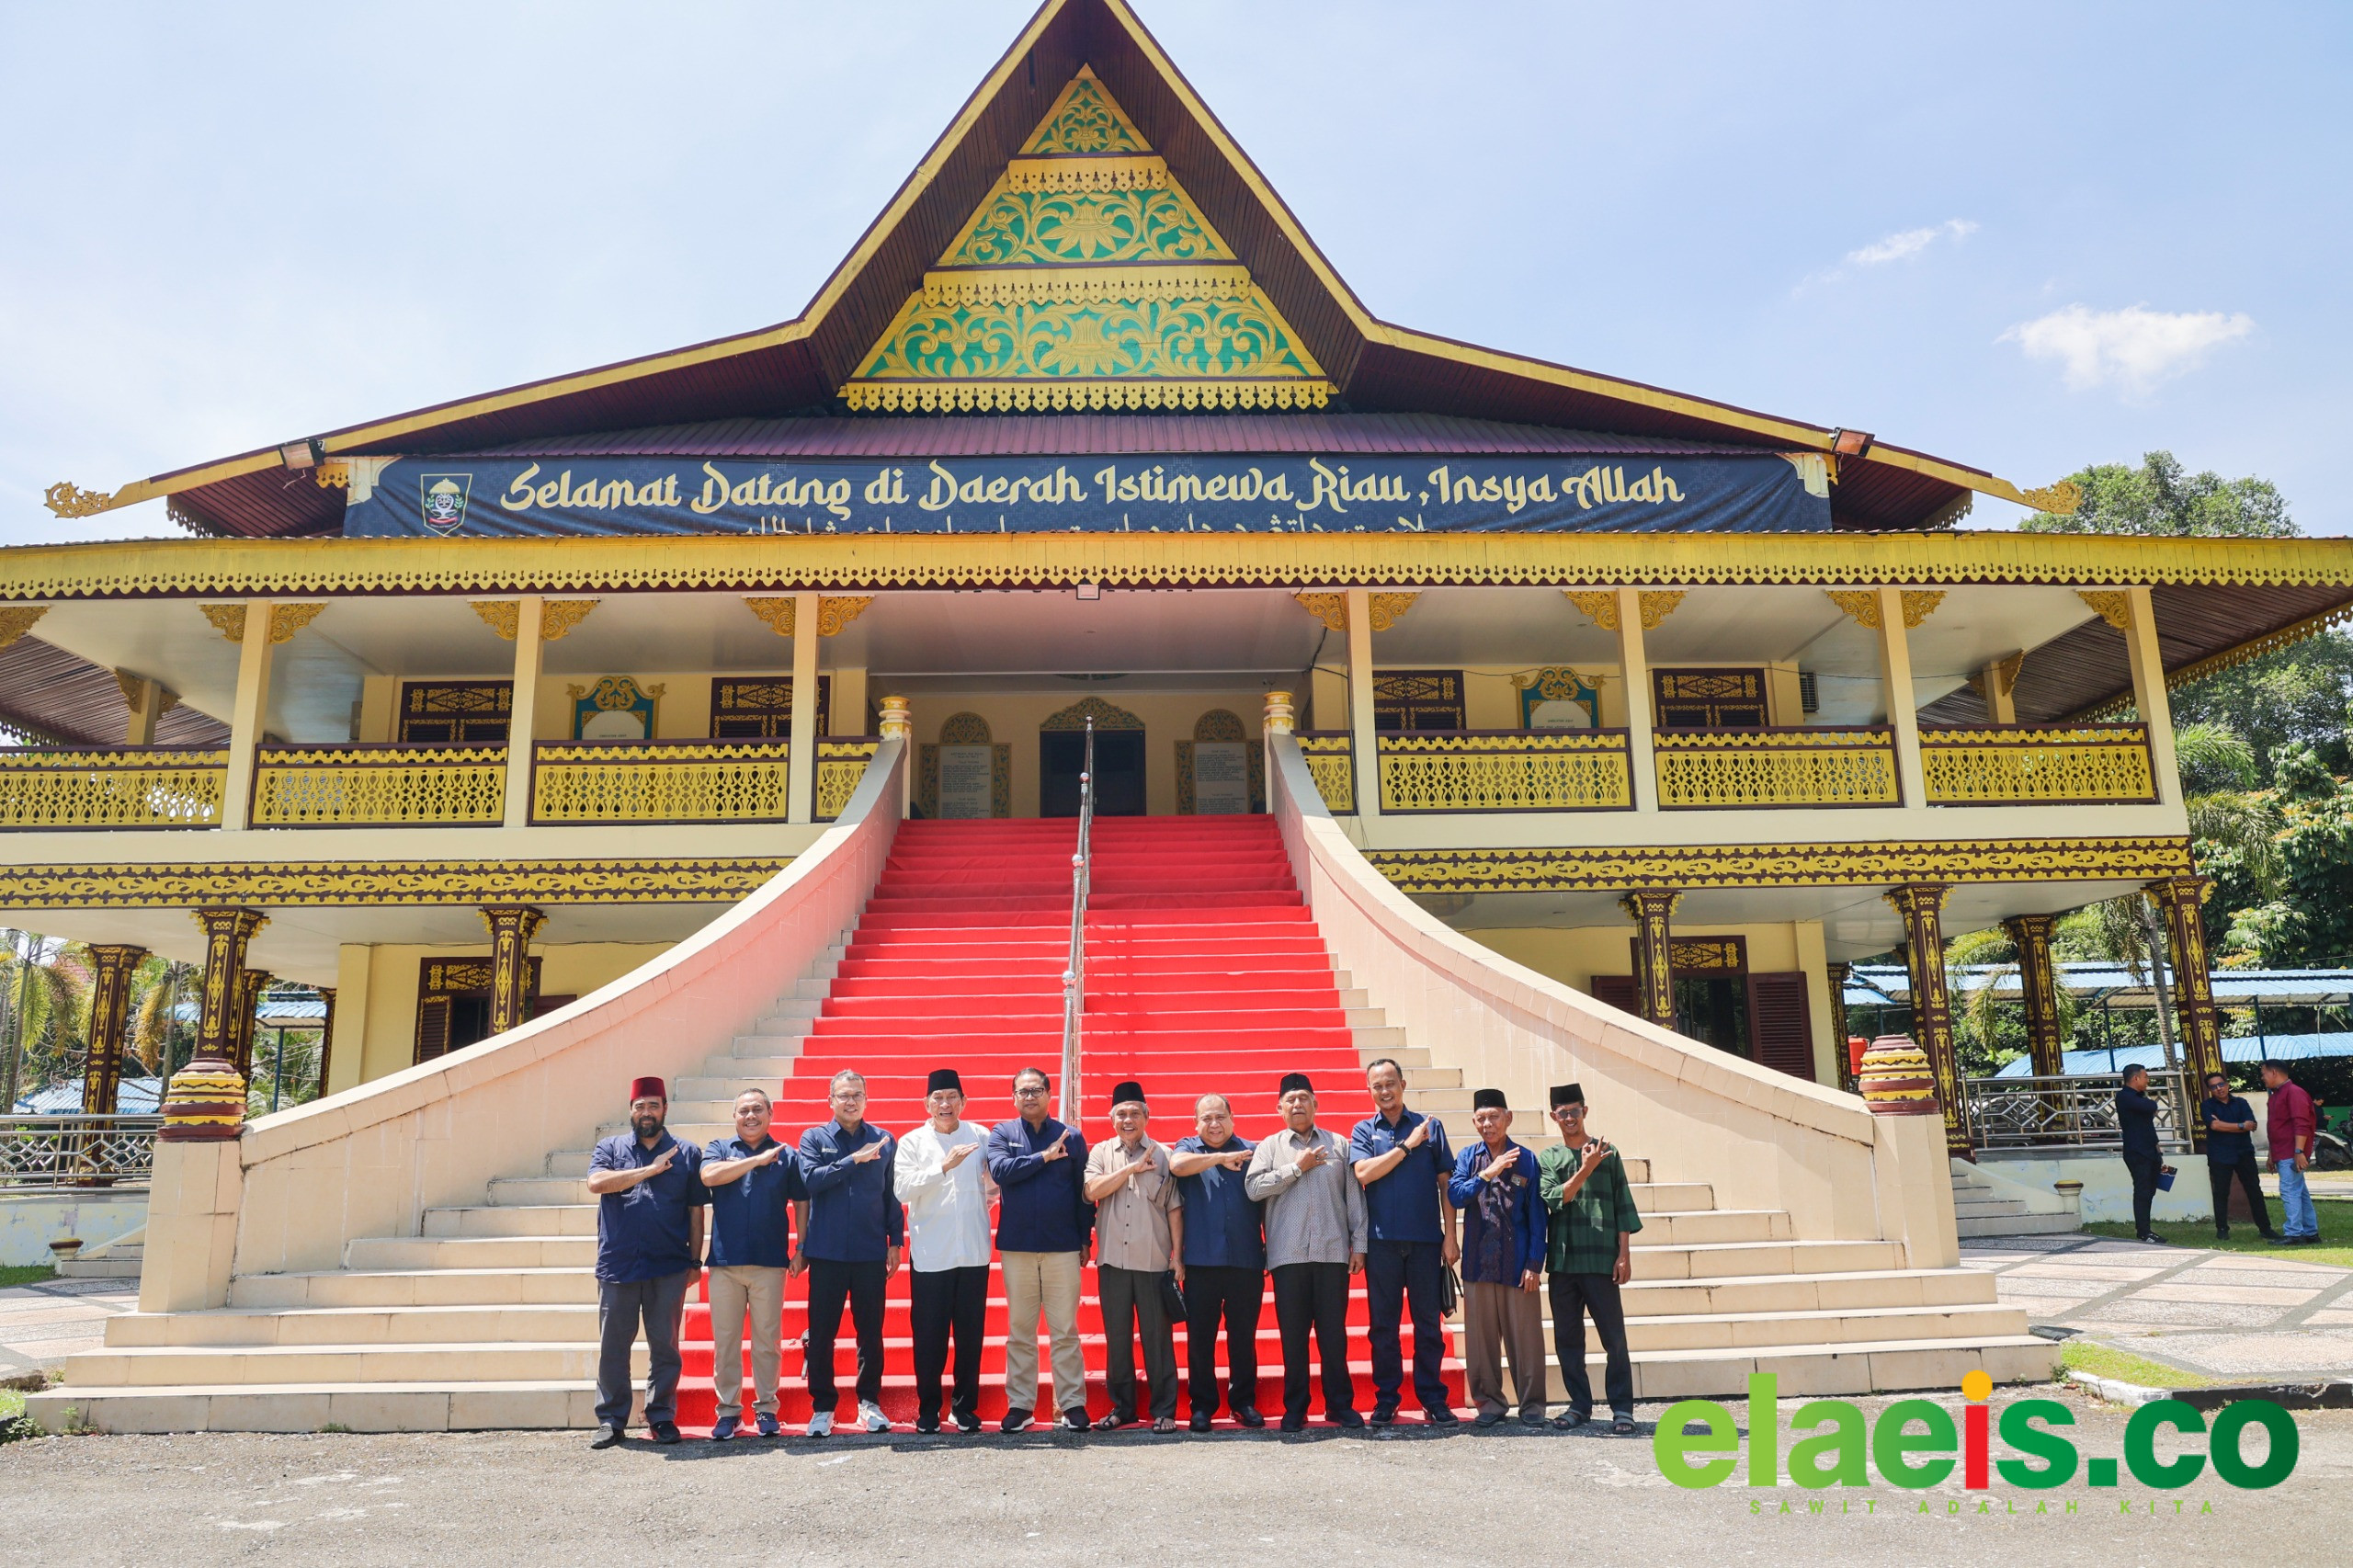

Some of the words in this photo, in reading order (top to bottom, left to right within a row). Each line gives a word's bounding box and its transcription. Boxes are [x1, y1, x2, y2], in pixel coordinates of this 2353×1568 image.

[499, 462, 682, 511] Selamat
[691, 461, 851, 520] Datang
[865, 468, 909, 505] di
[919, 459, 1086, 511] Daerah
[1095, 465, 1293, 505] Istimewa
[1296, 457, 1411, 514] Riau
[1562, 466, 1685, 510] Allah
